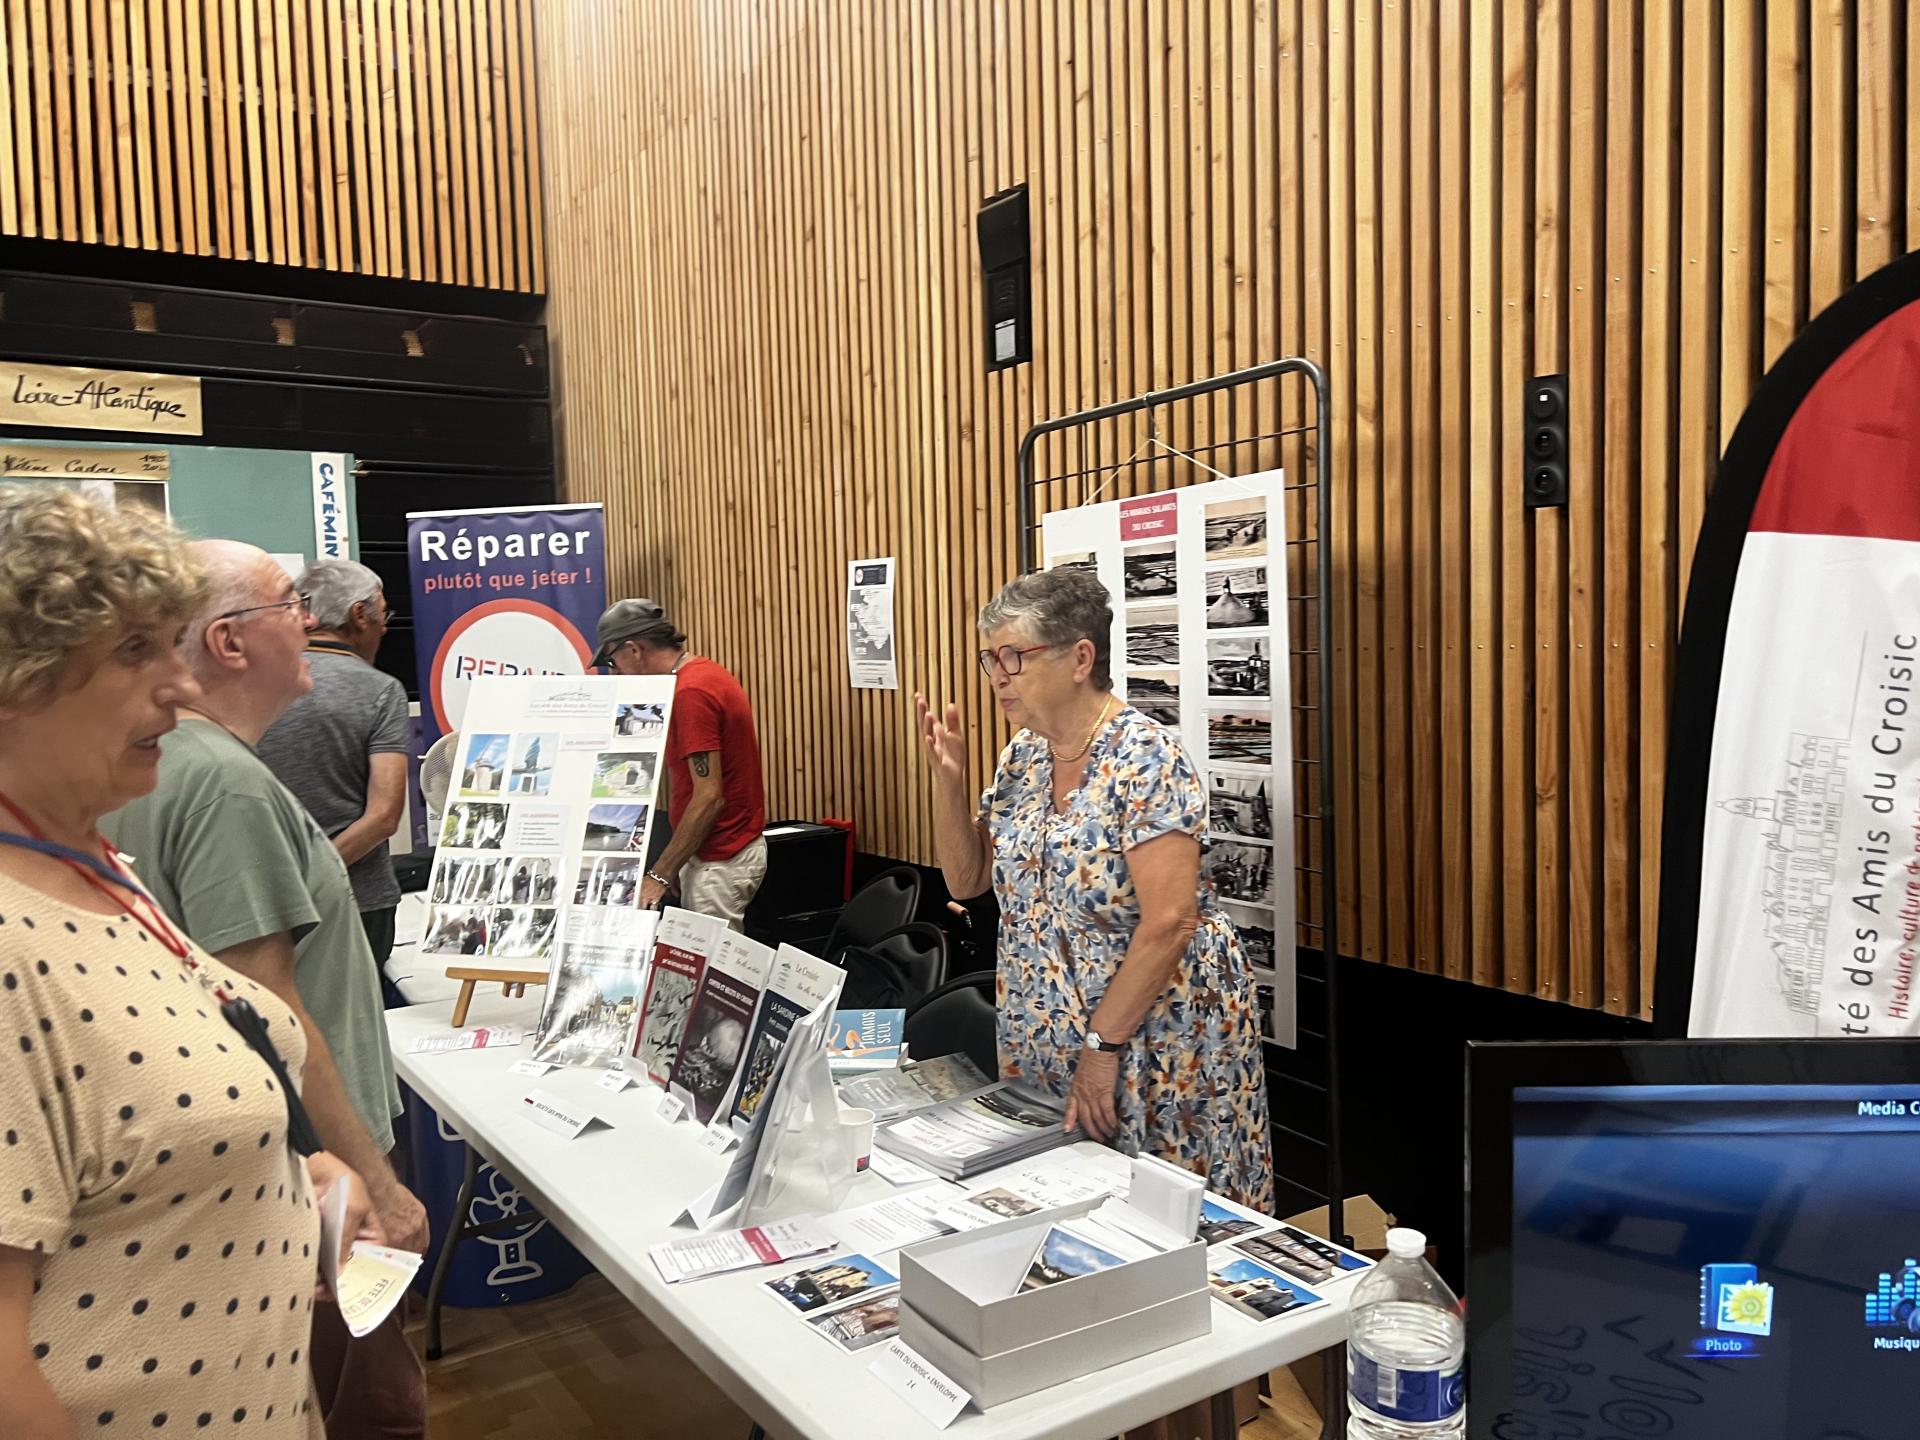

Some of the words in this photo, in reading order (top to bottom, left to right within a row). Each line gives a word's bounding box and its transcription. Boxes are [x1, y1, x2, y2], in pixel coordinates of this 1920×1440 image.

[420, 529, 590, 567] Réparer
[424, 572, 482, 594] plutôt
[489, 575, 526, 591] que
[531, 569, 578, 590] jeter
[1871, 633, 1917, 756] Croisic
[1864, 771, 1897, 815] du
[1852, 828, 1891, 915] Amis
[1898, 881, 1920, 942] culture
[1842, 927, 1879, 987] des
[1887, 947, 1915, 1020] Histoire,
[862, 1011, 876, 1045] JAMAIS
[877, 1020, 891, 1044] SEUL
[1840, 1002, 1870, 1036] té
[1858, 1101, 1905, 1116] Media
[1910, 1101, 1920, 1116] C
[1705, 1339, 1742, 1353] Photo
[1874, 1336, 1920, 1352] Musiqu
[890, 1344, 905, 1359] CARTE
[903, 1355, 912, 1364] DU
[930, 1377, 958, 1402] ENVELOPPE
